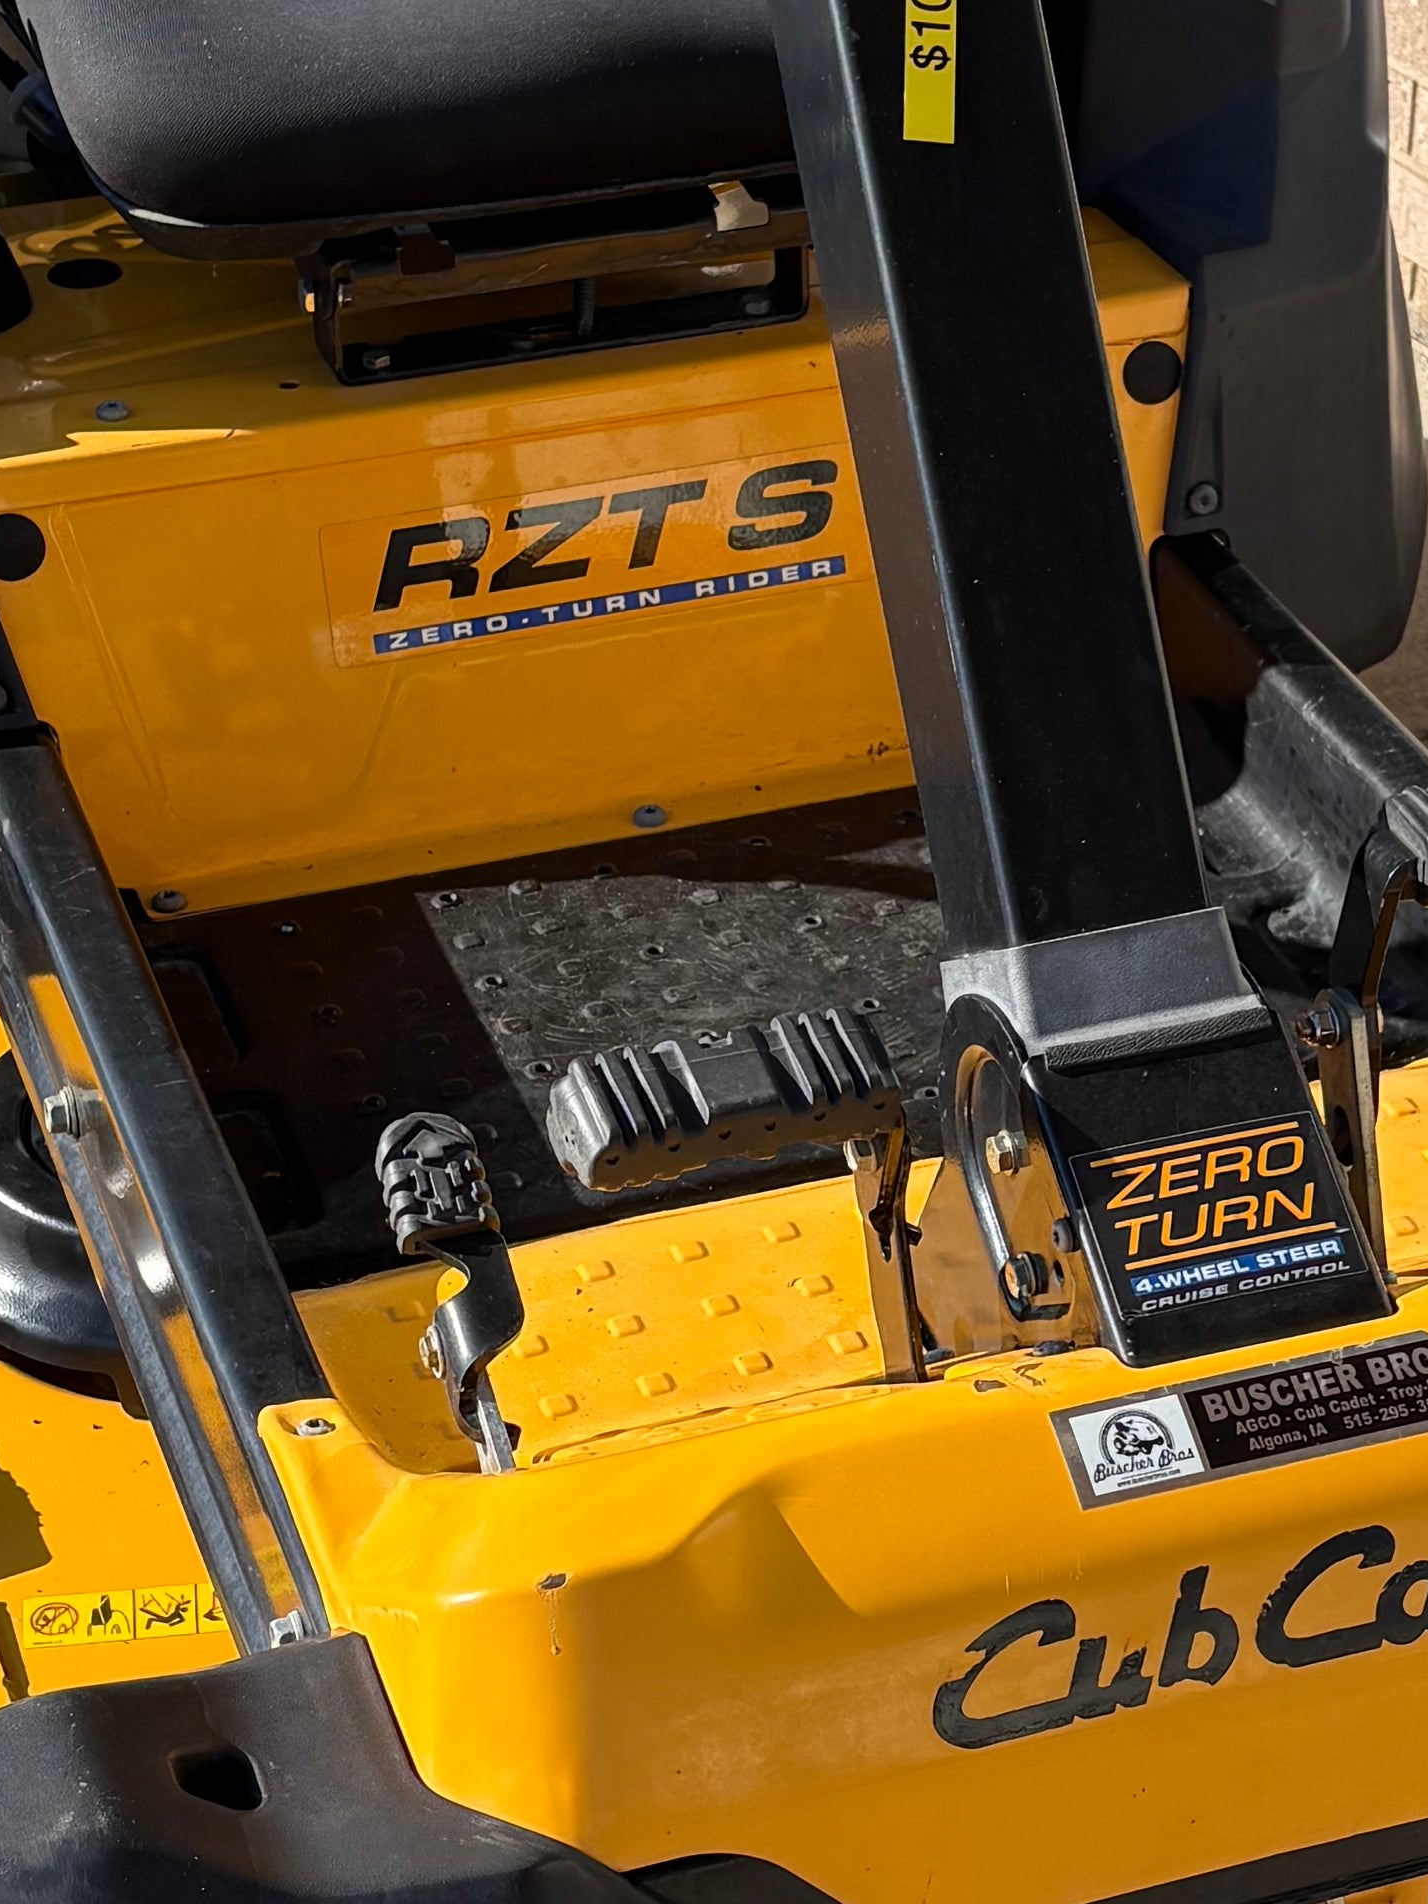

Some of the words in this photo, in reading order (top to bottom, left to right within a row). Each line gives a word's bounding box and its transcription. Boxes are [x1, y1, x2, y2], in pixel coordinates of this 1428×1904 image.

[373, 479, 708, 613] RZT
[727, 459, 838, 552] S
[694, 559, 832, 598] RIDER
[1106, 1135, 1305, 1211] ZERO
[1114, 1182, 1315, 1256] TURN
[1135, 1257, 1252, 1294] 4-WHEEL
[1256, 1241, 1341, 1271] STEER
[1141, 1283, 1229, 1313] CRUISE
[1238, 1260, 1351, 1292] CONTROL
[1201, 1363, 1365, 1423] BUSCHER
[1235, 1414, 1282, 1436] AGCO
[1294, 1403, 1327, 1422] Cub
[1328, 1392, 1377, 1414] Cadet
[1248, 1429, 1308, 1452] Algona,
[1310, 1421, 1329, 1438] IA
[1093, 1456, 1155, 1484] Buscher
[932, 1565, 1240, 1750] Cub
